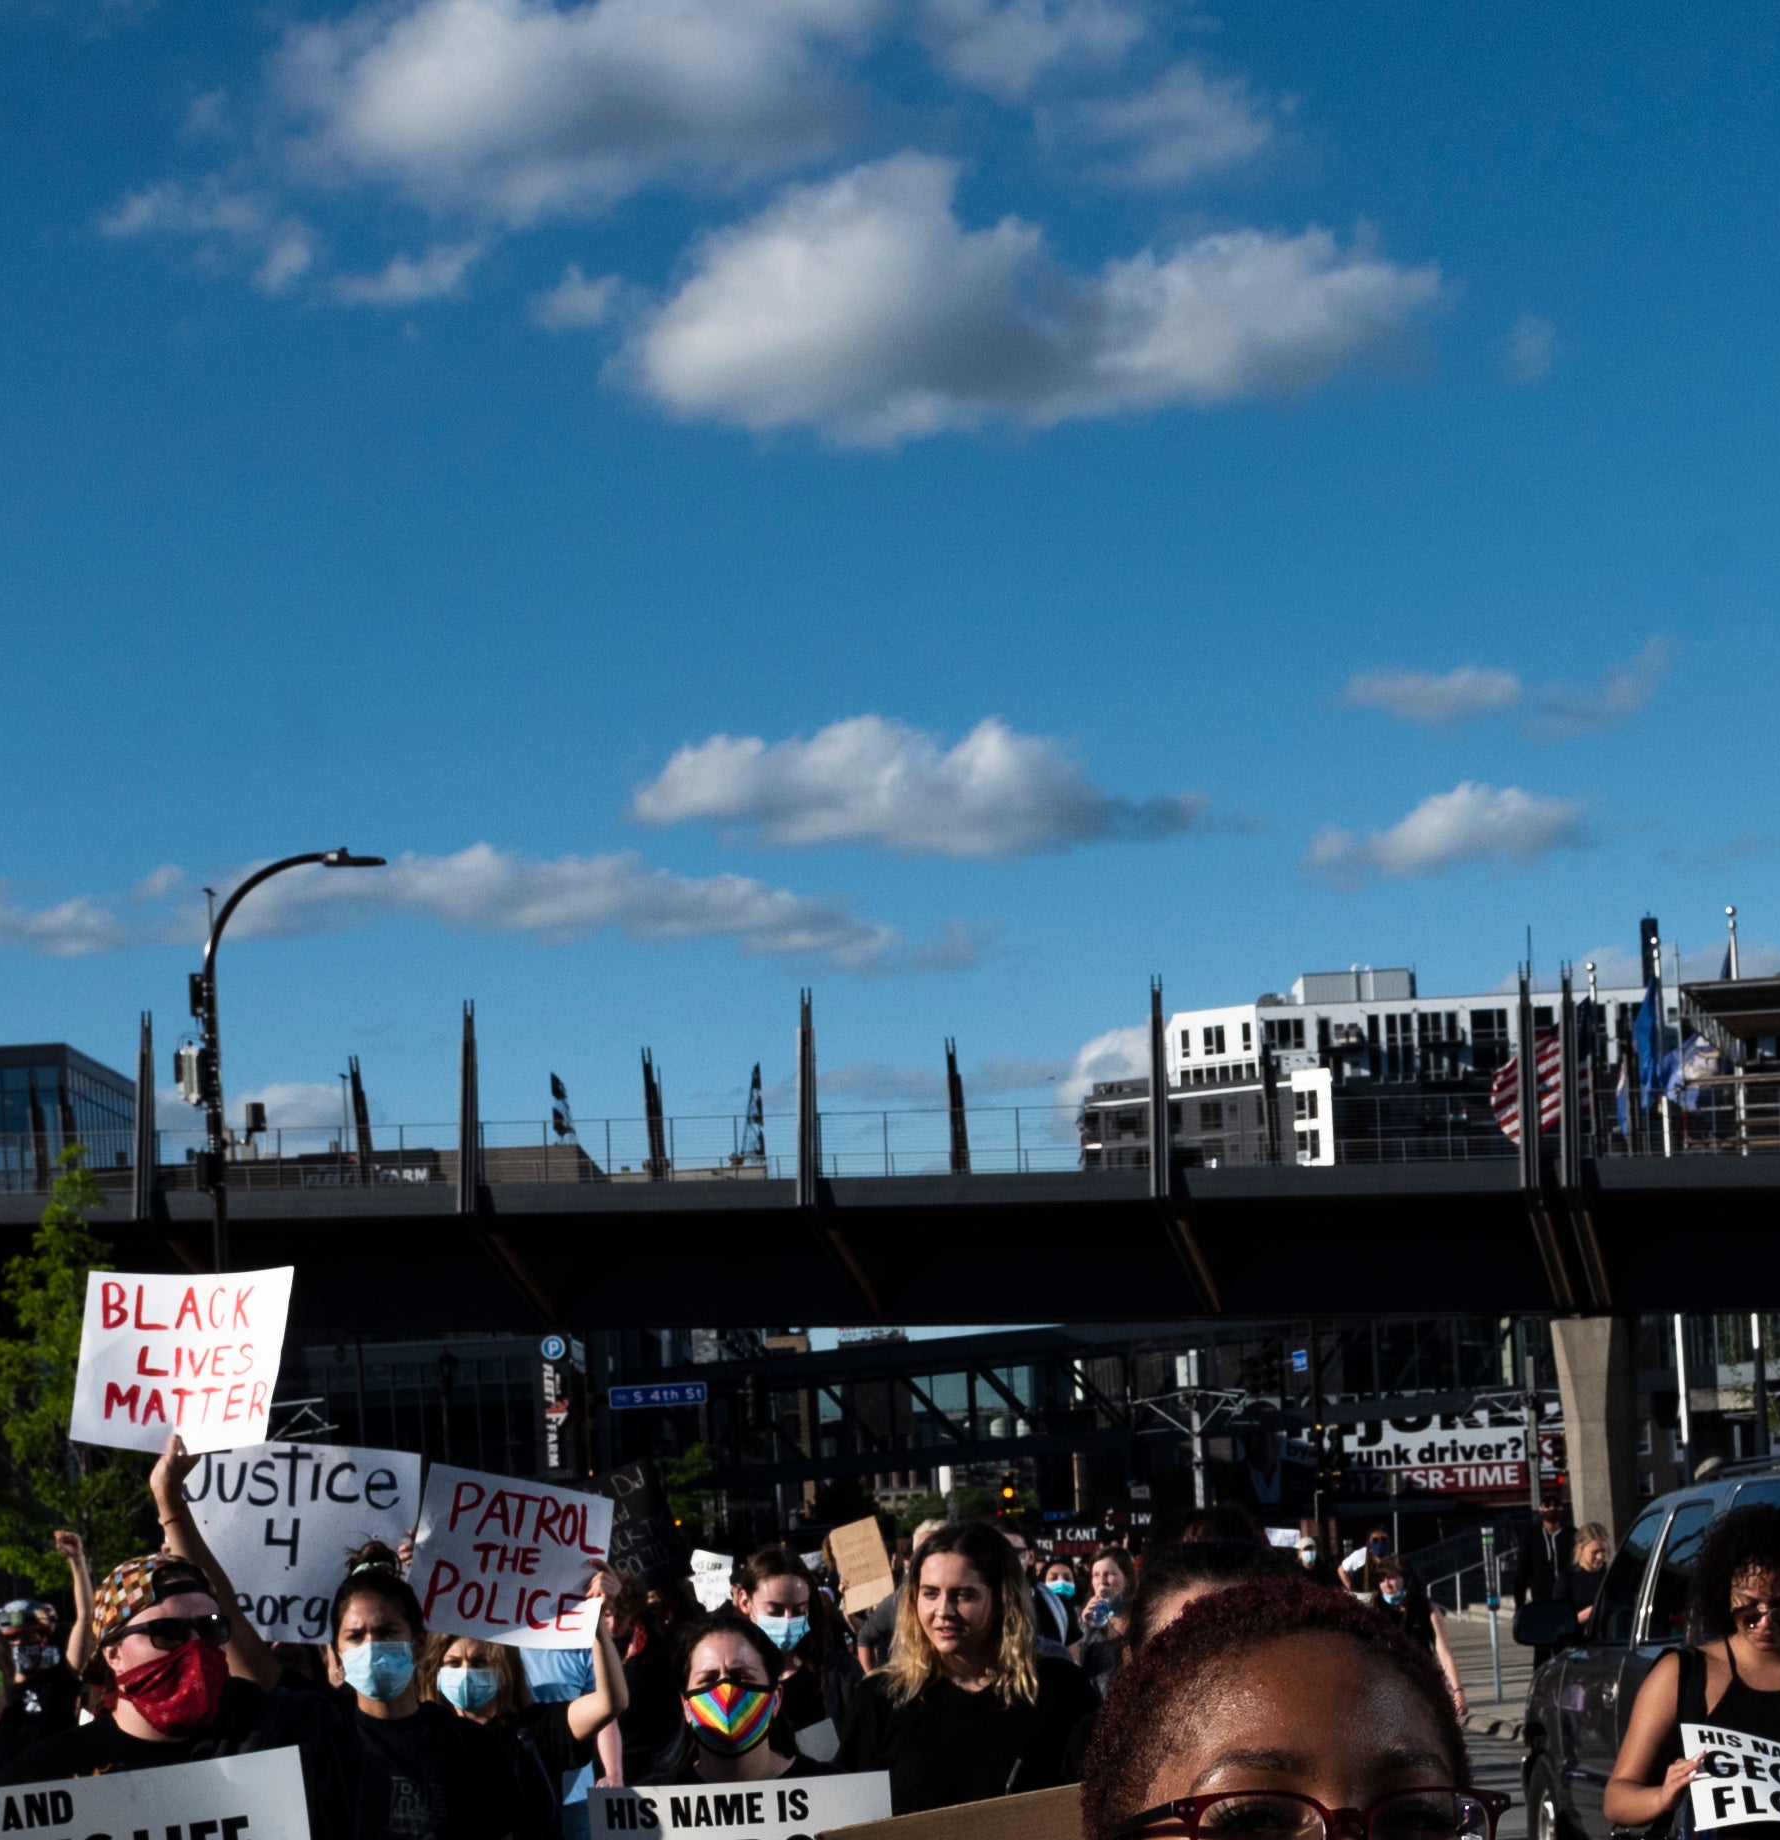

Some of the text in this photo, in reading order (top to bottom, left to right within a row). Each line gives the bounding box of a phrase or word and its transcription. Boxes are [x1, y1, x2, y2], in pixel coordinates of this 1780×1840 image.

[102, 1282, 254, 1331] BLACK
[137, 1343, 254, 1378] LIVES
[104, 1381, 268, 1427] MATTER
[632, 1390, 644, 1404] S
[649, 1388, 681, 1402] 4th
[685, 1386, 703, 1400] St
[1345, 1443, 1409, 1467] runk
[1415, 1435, 1520, 1464] driver?
[448, 1481, 605, 1556] PATROL
[1066, 1528, 1098, 1541] CANT
[265, 1518, 300, 1566] 4
[473, 1541, 542, 1575] THE
[235, 1592, 331, 1638] eorg
[423, 1559, 584, 1632] POLICE
[1698, 1730, 1743, 1748] HIS
[2, 1790, 73, 1831] AND
[605, 1789, 810, 1830] HIS NAME IS
